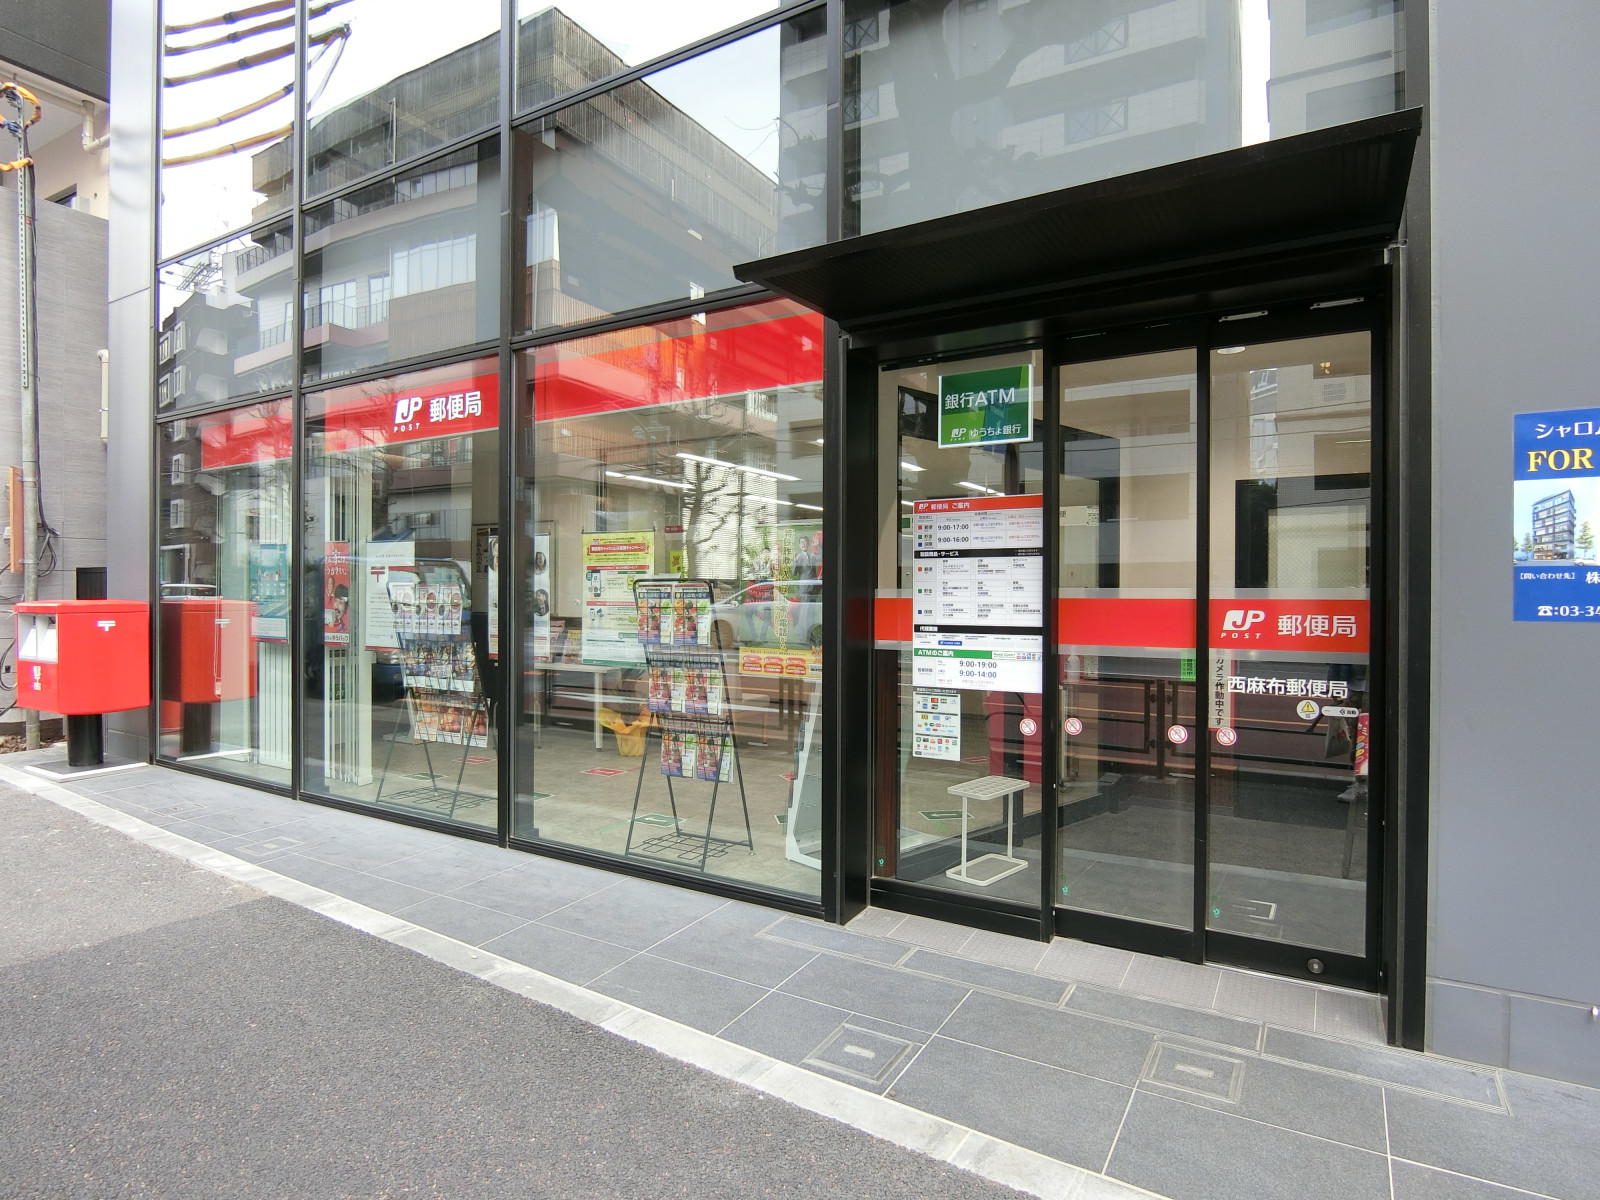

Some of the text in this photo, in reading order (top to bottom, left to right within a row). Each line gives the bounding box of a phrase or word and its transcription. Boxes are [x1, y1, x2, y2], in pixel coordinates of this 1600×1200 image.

[944, 387, 1015, 410] 銀行ATM
[430, 391, 482, 422] 郵便局
[393, 422, 421, 433] POST
[970, 424, 1022, 438] ゆうちょ銀行
[1526, 448, 1594, 472] FOR
[937, 523, 969, 531] 9:00-17:00
[937, 536, 969, 544] 9:00-16:00
[1520, 572, 1576, 581] 【問い合わせ先】
[1277, 614, 1357, 638] 郵便局
[959, 660, 997, 669] 9:00-19:00
[959, 669, 997, 678] 9:00-14:00
[1227, 675, 1349, 699] 西麻布郵便局
